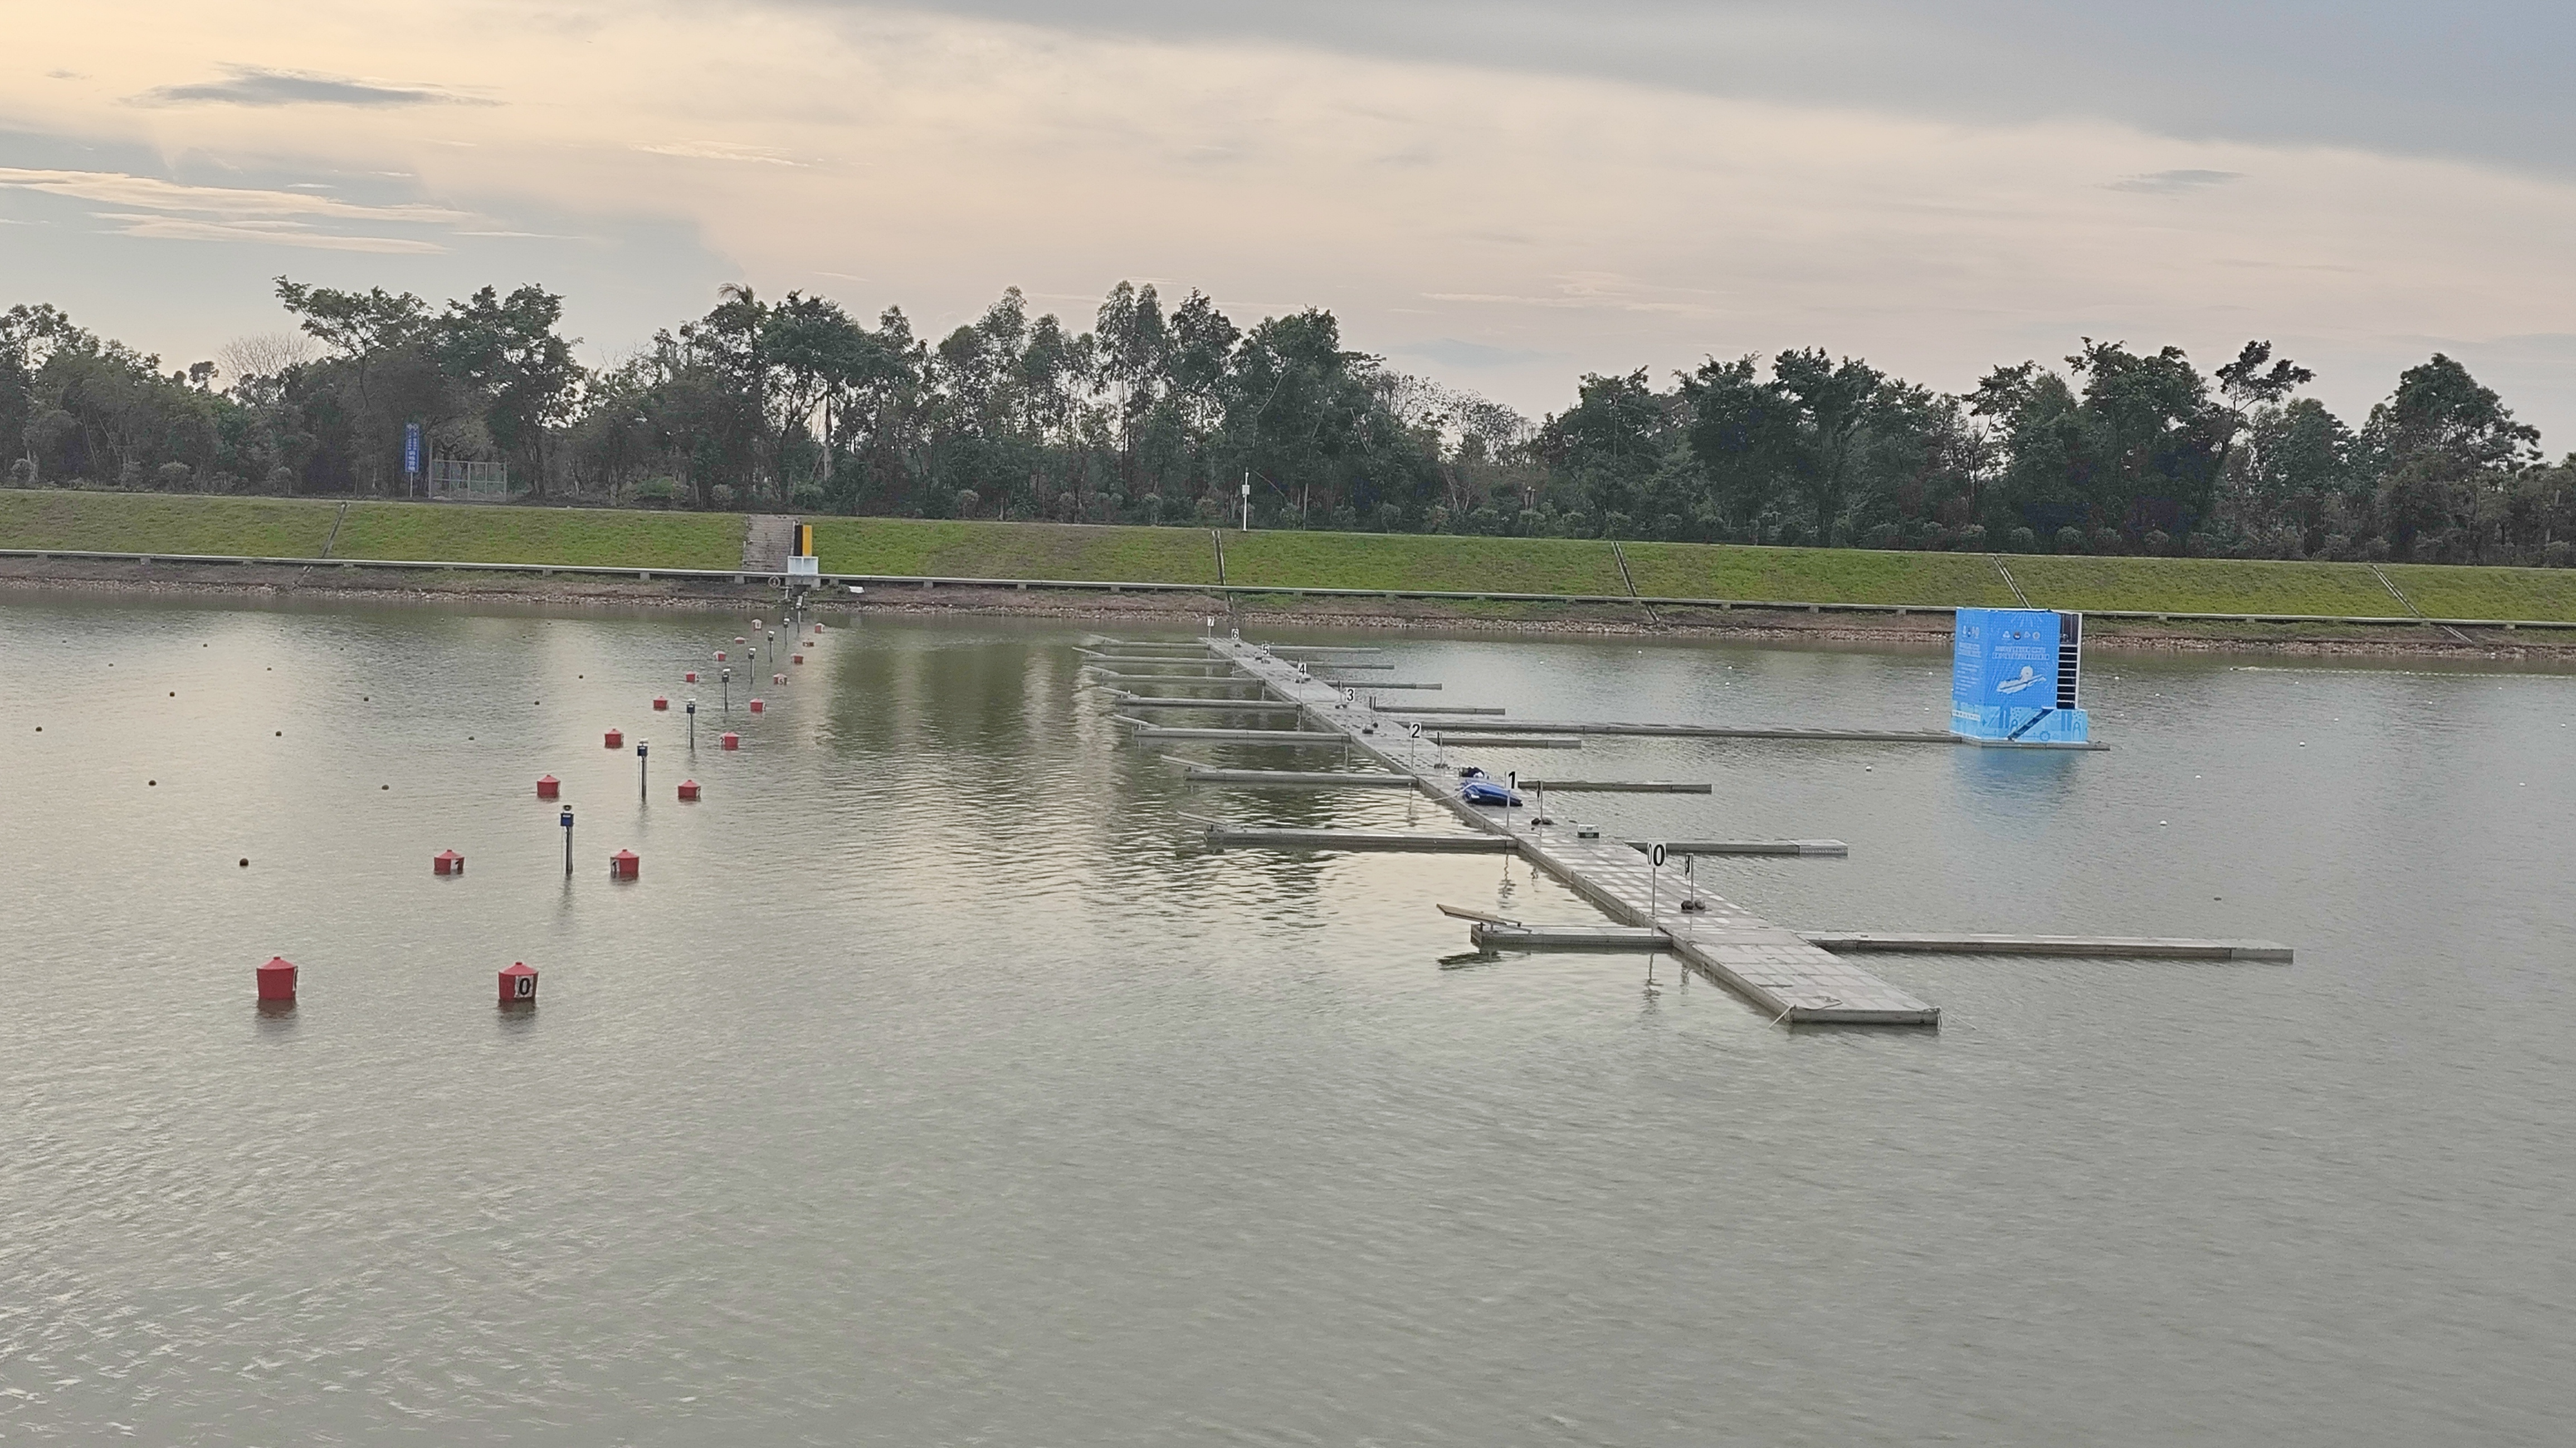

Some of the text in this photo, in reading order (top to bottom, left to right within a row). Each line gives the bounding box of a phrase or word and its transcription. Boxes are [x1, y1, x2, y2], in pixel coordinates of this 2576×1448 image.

[1208, 617, 1213, 625] 7
[1232, 629, 1238, 638] 6
[1262, 645, 1269, 655] 5
[1299, 664, 1305, 675] 4
[1346, 688, 1354, 701] 3
[1412, 723, 1420, 738] 2
[1508, 771, 1516, 789] 1
[1653, 844, 1665, 867] 0
[519, 977, 531, 996] 0
